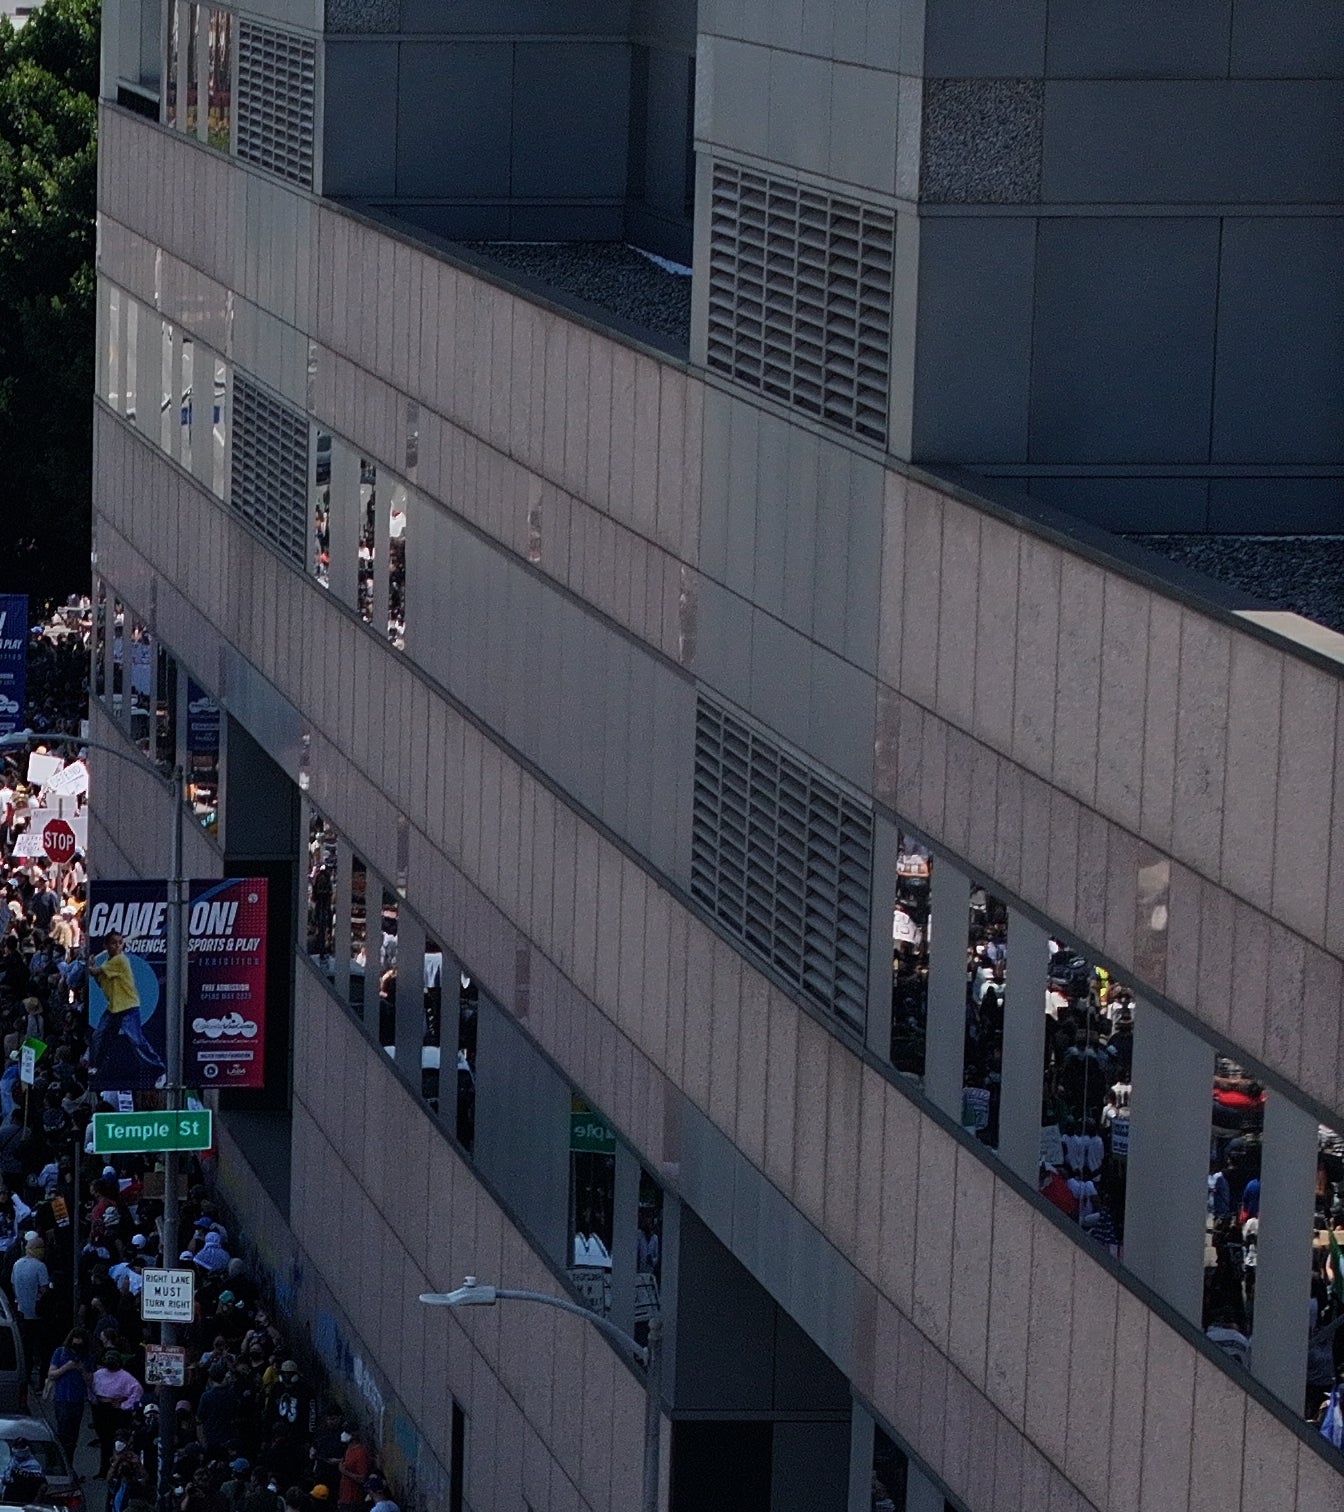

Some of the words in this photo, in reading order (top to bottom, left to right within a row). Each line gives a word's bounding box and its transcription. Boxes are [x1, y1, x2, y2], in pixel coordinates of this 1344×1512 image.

[4, 639, 22, 650] PLAY
[43, 830, 75, 851] STOP
[89, 901, 168, 937] GAME
[190, 901, 239, 935] ON!
[187, 938, 225, 952] SPORTS
[226, 938, 234, 952] &
[234, 938, 260, 952] PLAY
[104, 1121, 169, 1141] Temple
[179, 1120, 200, 1137] St
[145, 1274, 167, 1283] RIGHT
[170, 1275, 191, 1284] LANE
[154, 1286, 181, 1297] MUST
[145, 1299, 165, 1307] TURN
[167, 1300, 191, 1309] RIGHT
